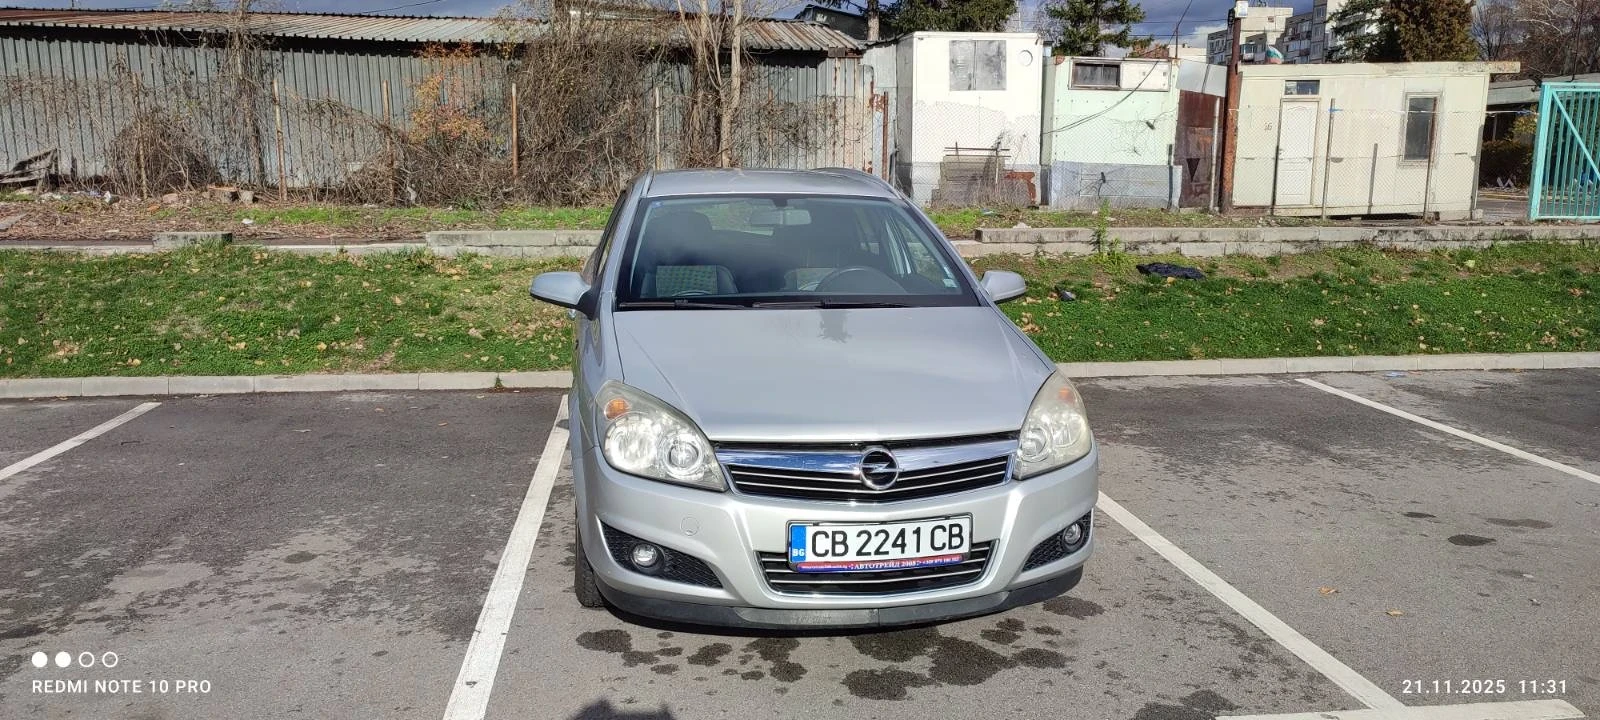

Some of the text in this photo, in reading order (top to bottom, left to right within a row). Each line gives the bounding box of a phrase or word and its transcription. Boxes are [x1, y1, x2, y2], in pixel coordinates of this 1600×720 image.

[811, 523, 964, 558] CB 2241 CB
[792, 548, 805, 557] BG
